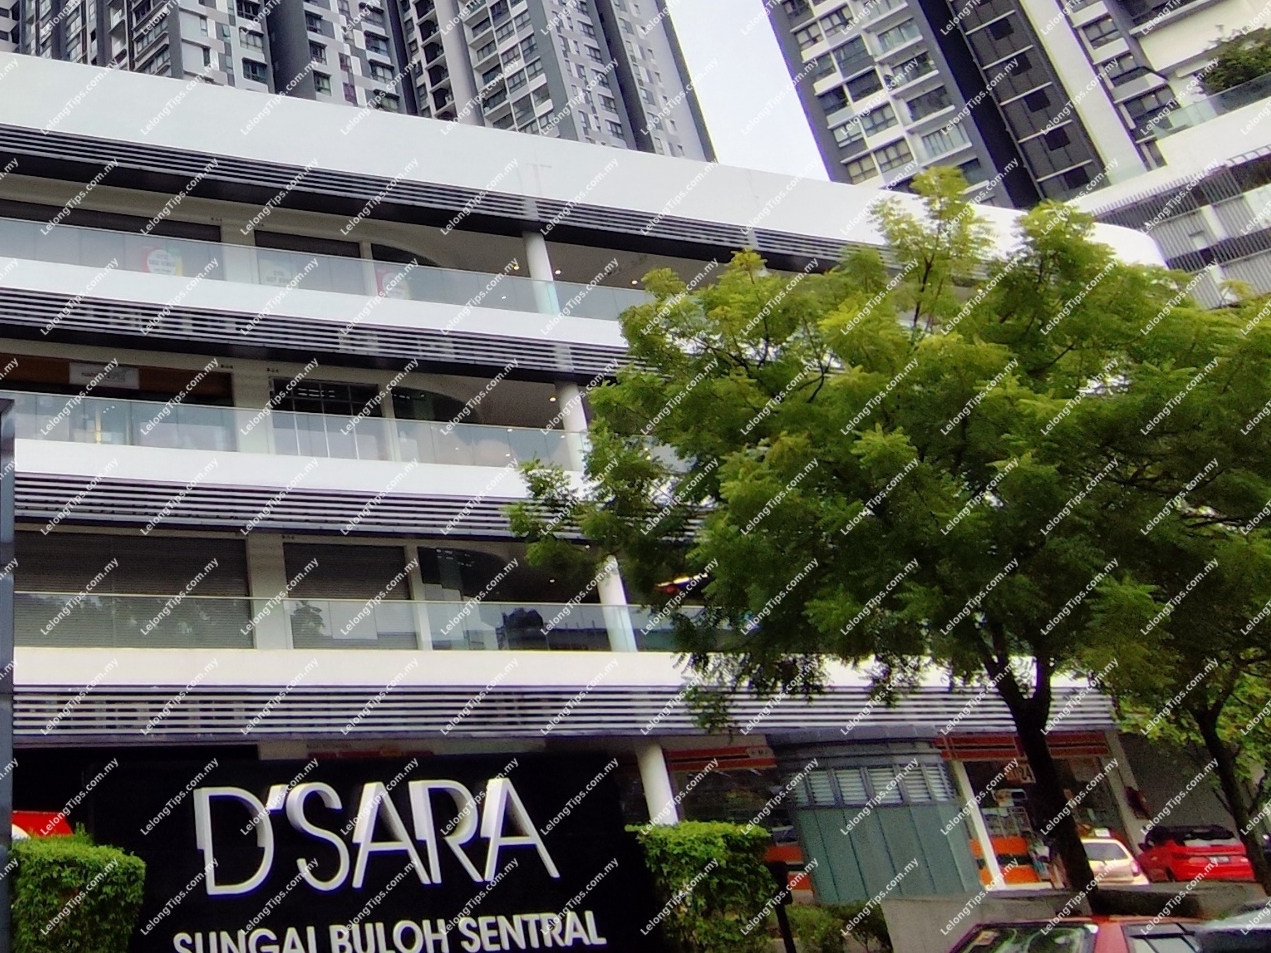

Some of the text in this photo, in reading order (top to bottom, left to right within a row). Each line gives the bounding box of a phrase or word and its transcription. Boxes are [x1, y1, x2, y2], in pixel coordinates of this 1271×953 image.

[193, 778, 560, 895] D'SARA
[173, 910, 607, 953] SUNGAI BULOH SENTRAL
